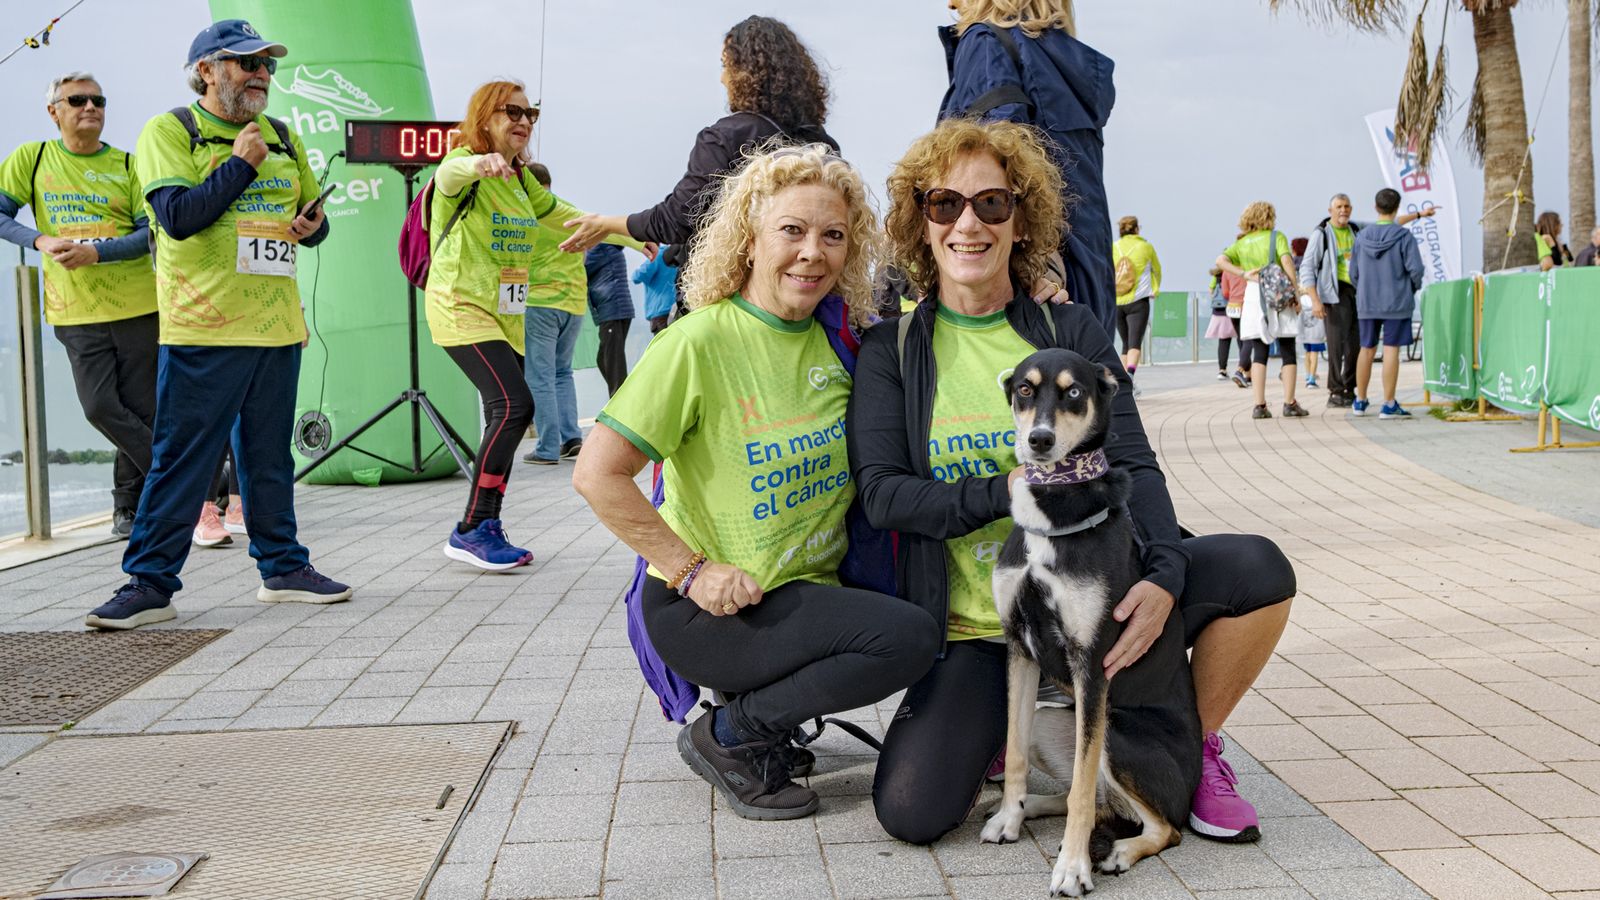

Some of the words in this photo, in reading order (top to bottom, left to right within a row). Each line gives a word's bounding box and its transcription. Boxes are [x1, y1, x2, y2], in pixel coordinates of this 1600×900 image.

[44, 192, 59, 202] En
[62, 192, 109, 204] marcha
[47, 203, 86, 214] contra
[492, 212, 509, 225] En
[491, 228, 526, 240] contra
[249, 237, 296, 264] 1525
[491, 240, 505, 252] el
[745, 441, 783, 467] En
[750, 453, 832, 493] contra
[753, 493, 780, 521] el
[785, 470, 851, 509] cánce
